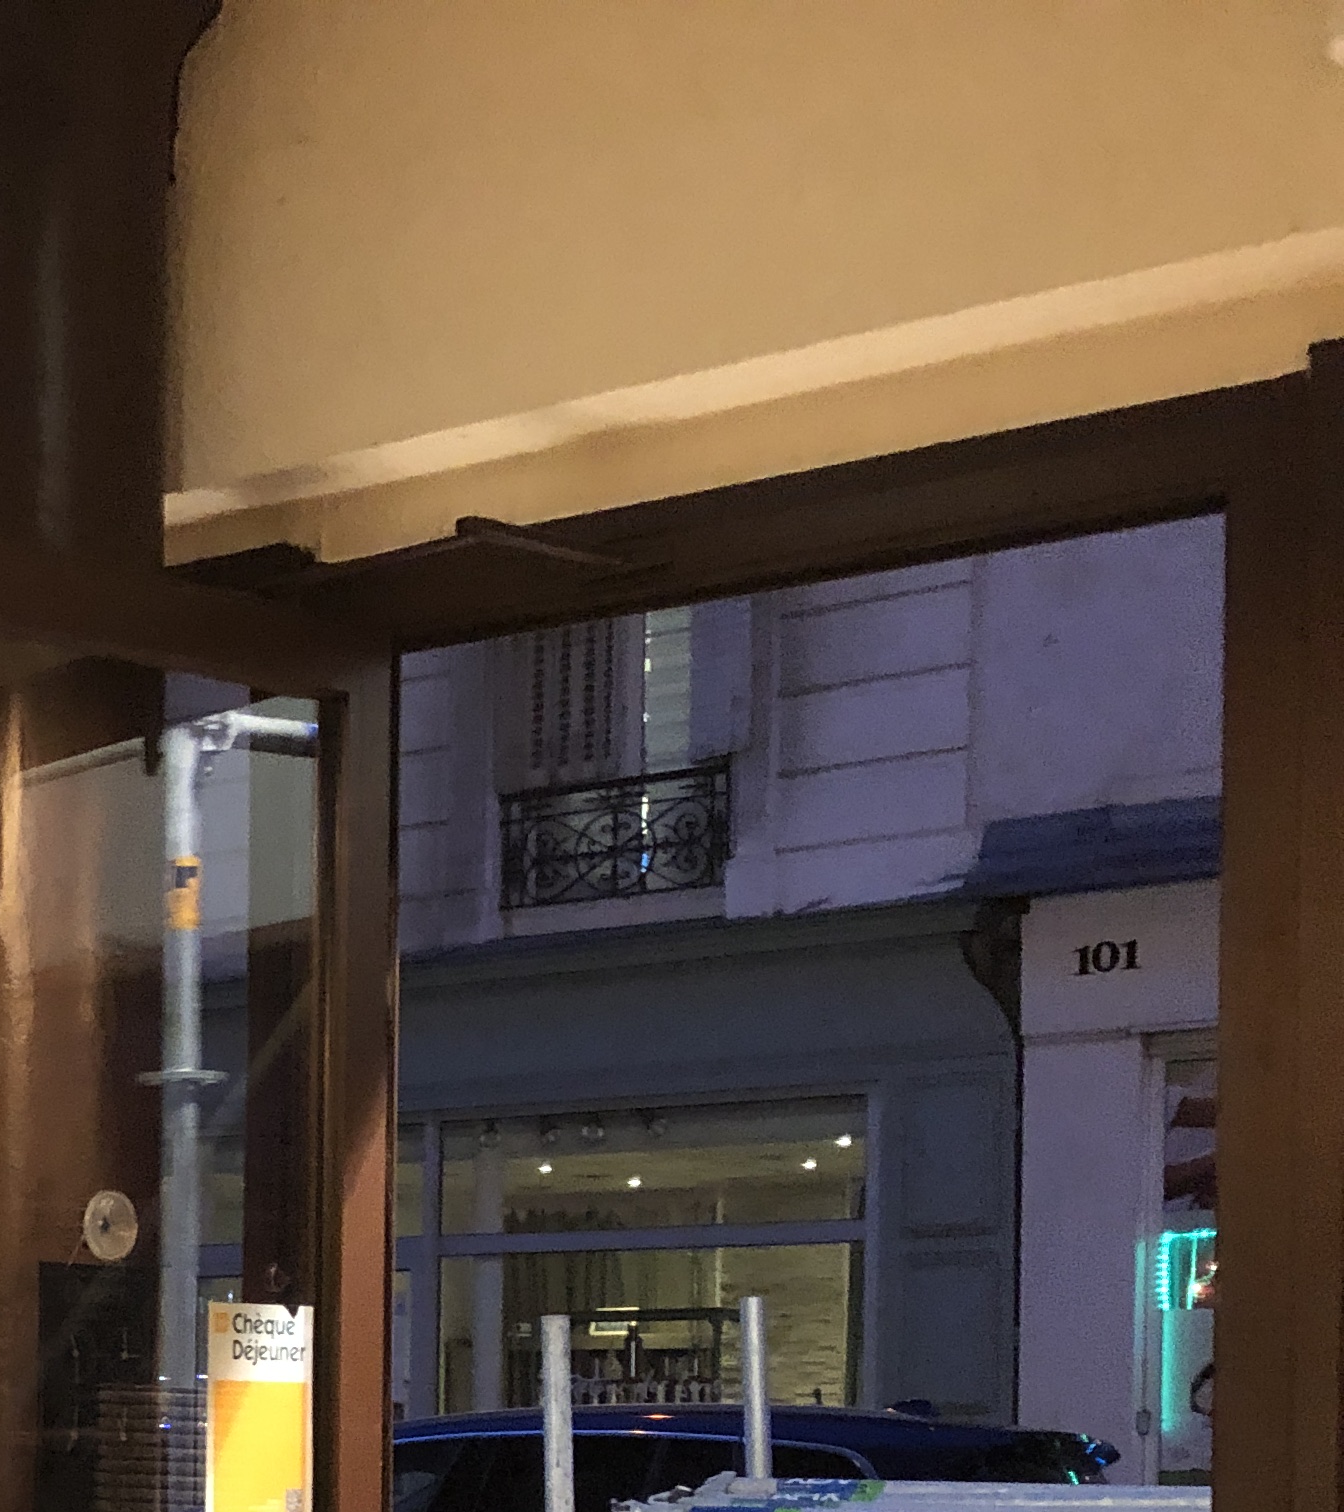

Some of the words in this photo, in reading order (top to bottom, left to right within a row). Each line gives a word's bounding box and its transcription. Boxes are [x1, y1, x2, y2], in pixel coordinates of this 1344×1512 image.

[1070, 939, 1141, 975] 101
[232, 1312, 295, 1338] Chèque
[232, 1338, 306, 1366] Déjeuner
